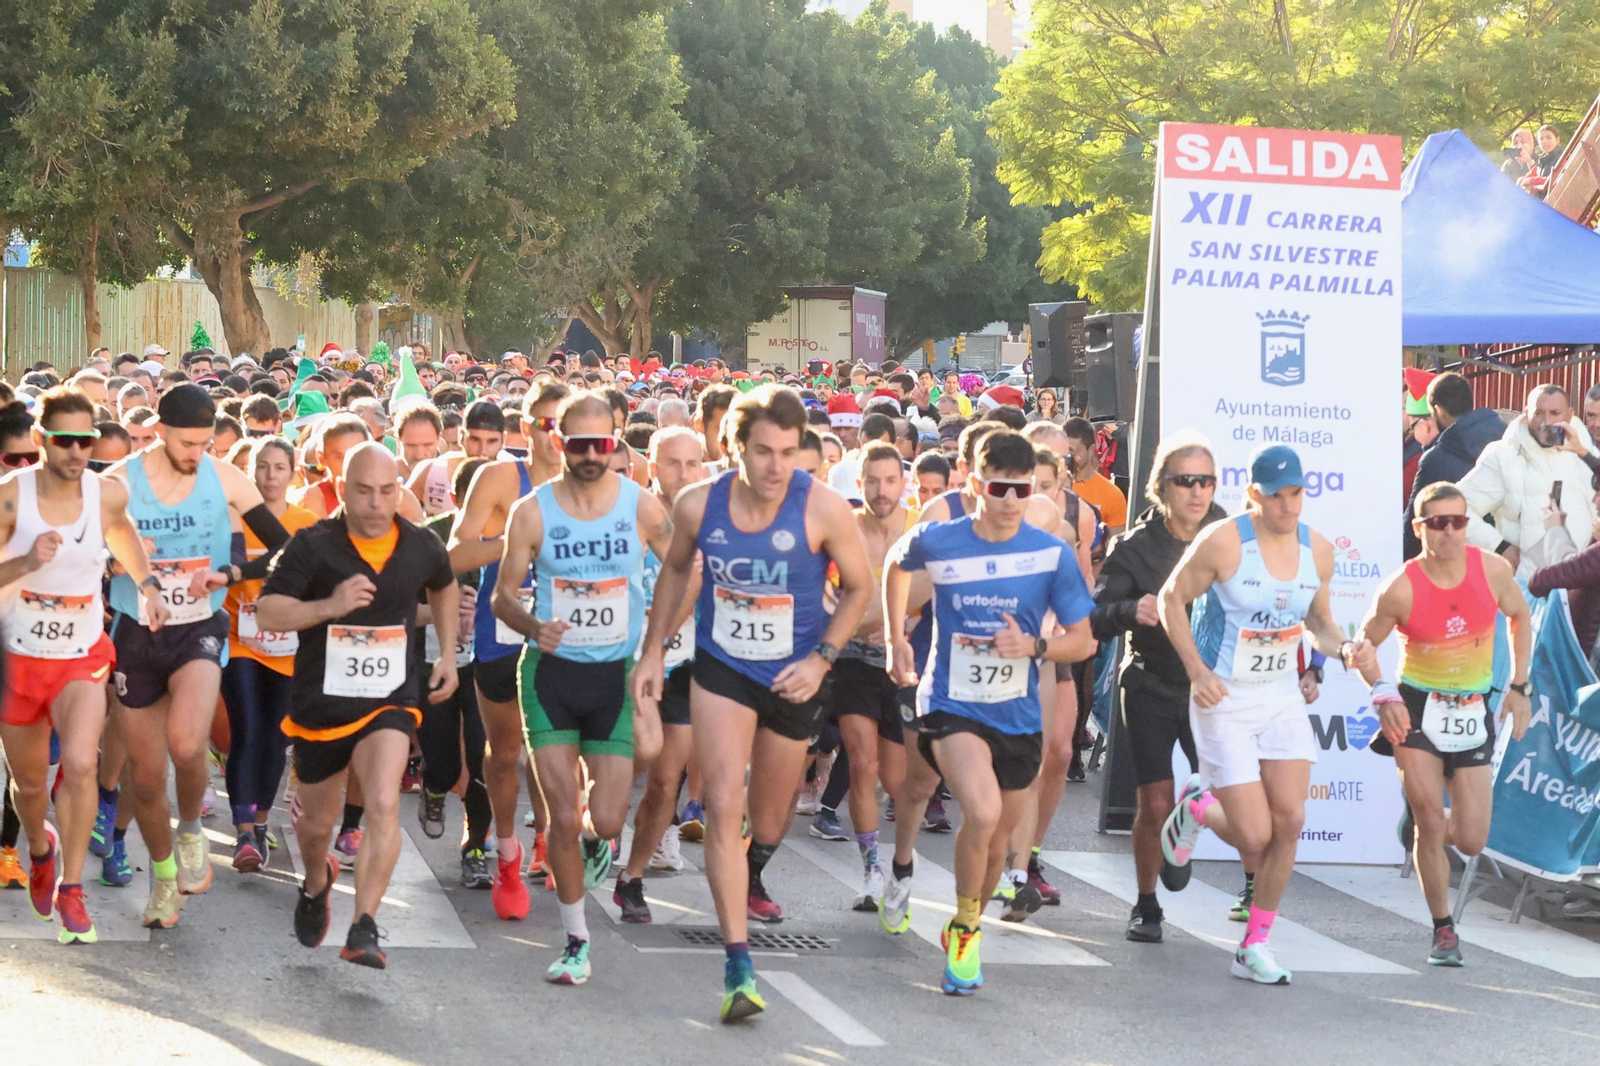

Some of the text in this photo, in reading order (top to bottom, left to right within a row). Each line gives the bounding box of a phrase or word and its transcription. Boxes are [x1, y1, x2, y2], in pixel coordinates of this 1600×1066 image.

[1175, 133, 1389, 182] SALIDA
[1180, 191, 1383, 234] XII CARRERA
[1188, 240, 1379, 267] SAN SILVESTRE
[1171, 268, 1394, 296] PALMA PALMILLA
[1215, 398, 1351, 420] Ayuntamiento
[1232, 425, 1334, 448] de Málaga
[1222, 466, 1344, 498] mga
[137, 512, 196, 532] nerja
[553, 533, 629, 561] nerja
[707, 555, 788, 587] RCM
[1334, 562, 1381, 578] ALEDA
[962, 594, 1019, 609] ortodent
[569, 607, 614, 628] 420
[30, 620, 75, 640] 484
[730, 620, 775, 642] 215
[345, 657, 390, 677] 369
[1250, 652, 1288, 672] 216
[968, 664, 1013, 684] 379
[1440, 717, 1477, 736] 150
